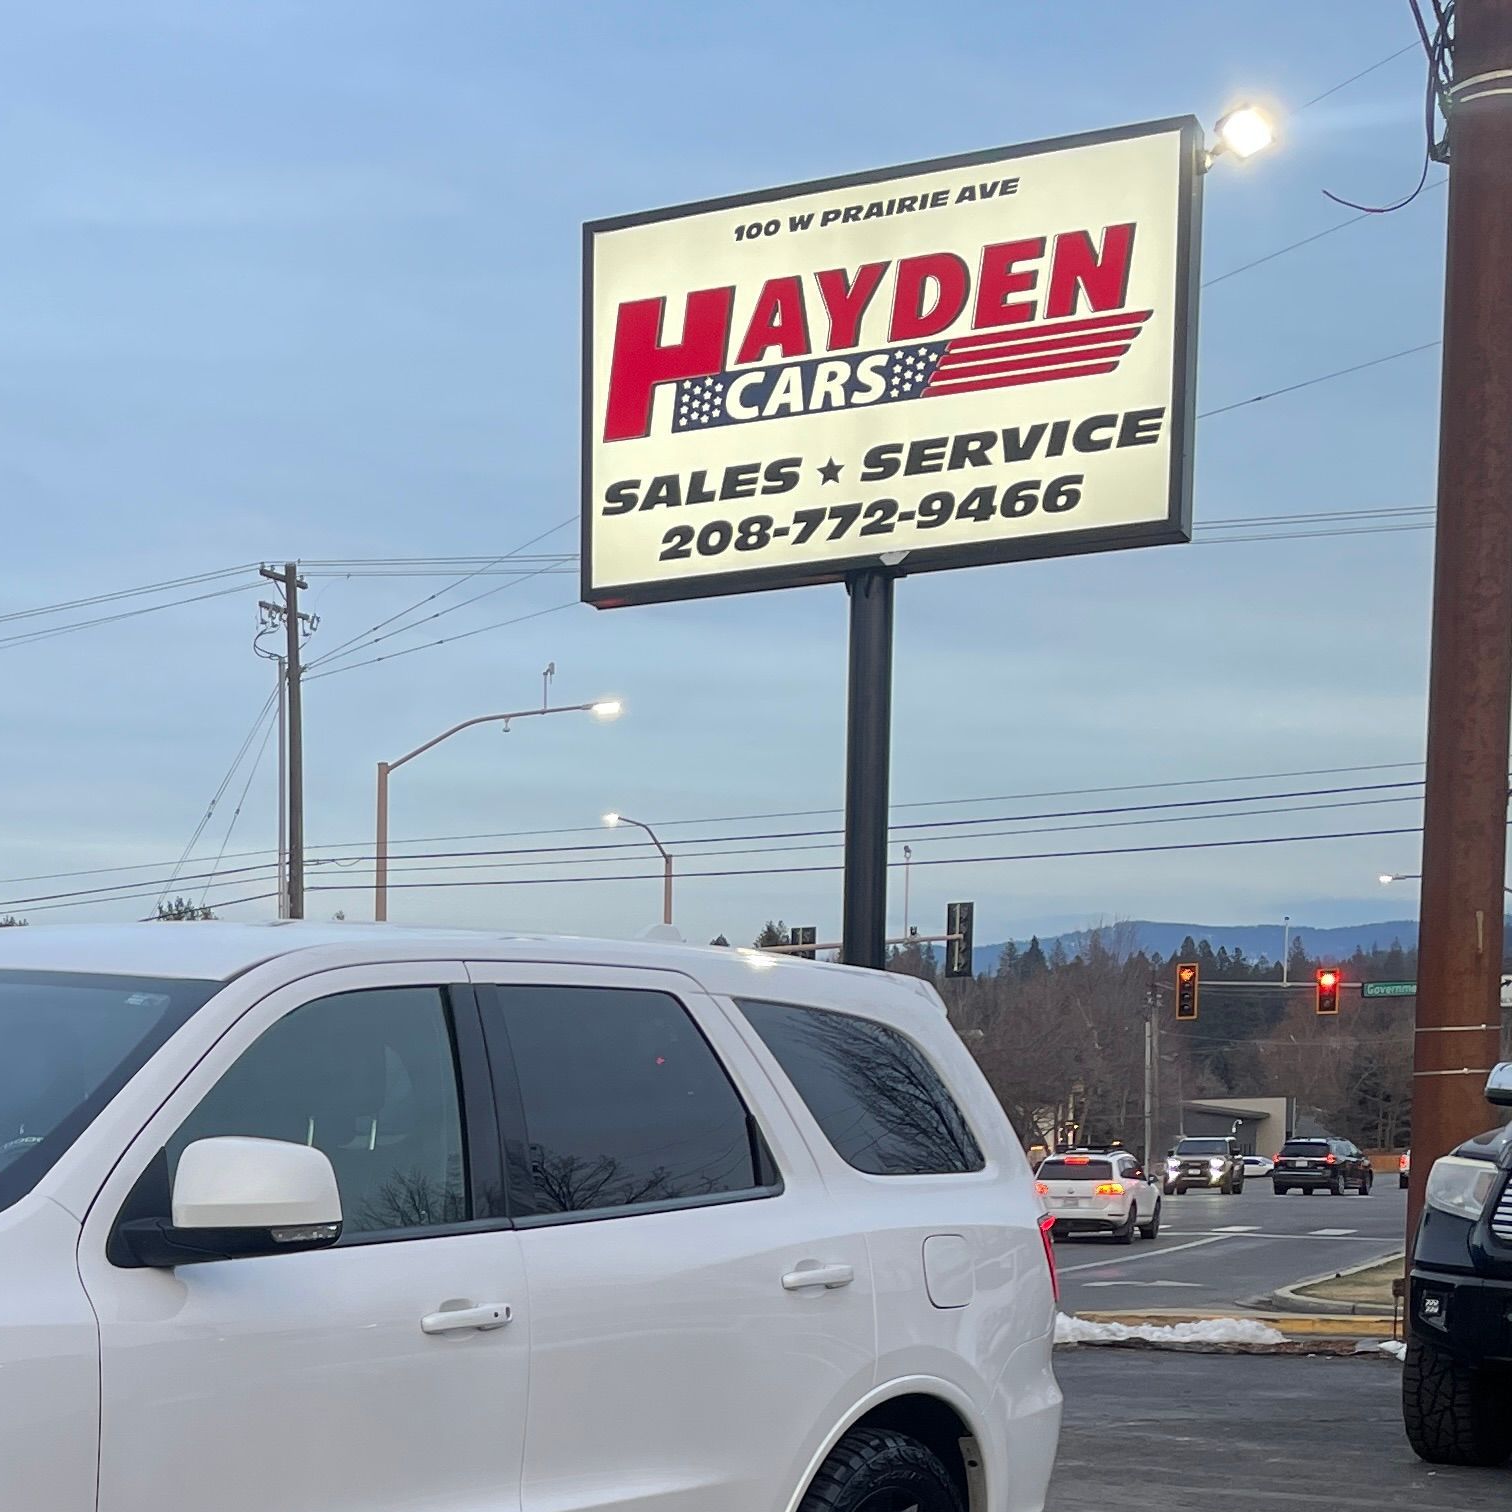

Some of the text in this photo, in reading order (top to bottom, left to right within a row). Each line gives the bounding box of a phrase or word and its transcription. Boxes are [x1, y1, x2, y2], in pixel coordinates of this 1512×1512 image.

[734, 177, 1021, 242] 100 W PRAIRIE AVE
[602, 222, 1137, 443] HAYDEN
[725, 354, 890, 421] CARS
[602, 407, 1166, 516] SALES SERVICE
[659, 474, 1085, 561] 208-772-9466
